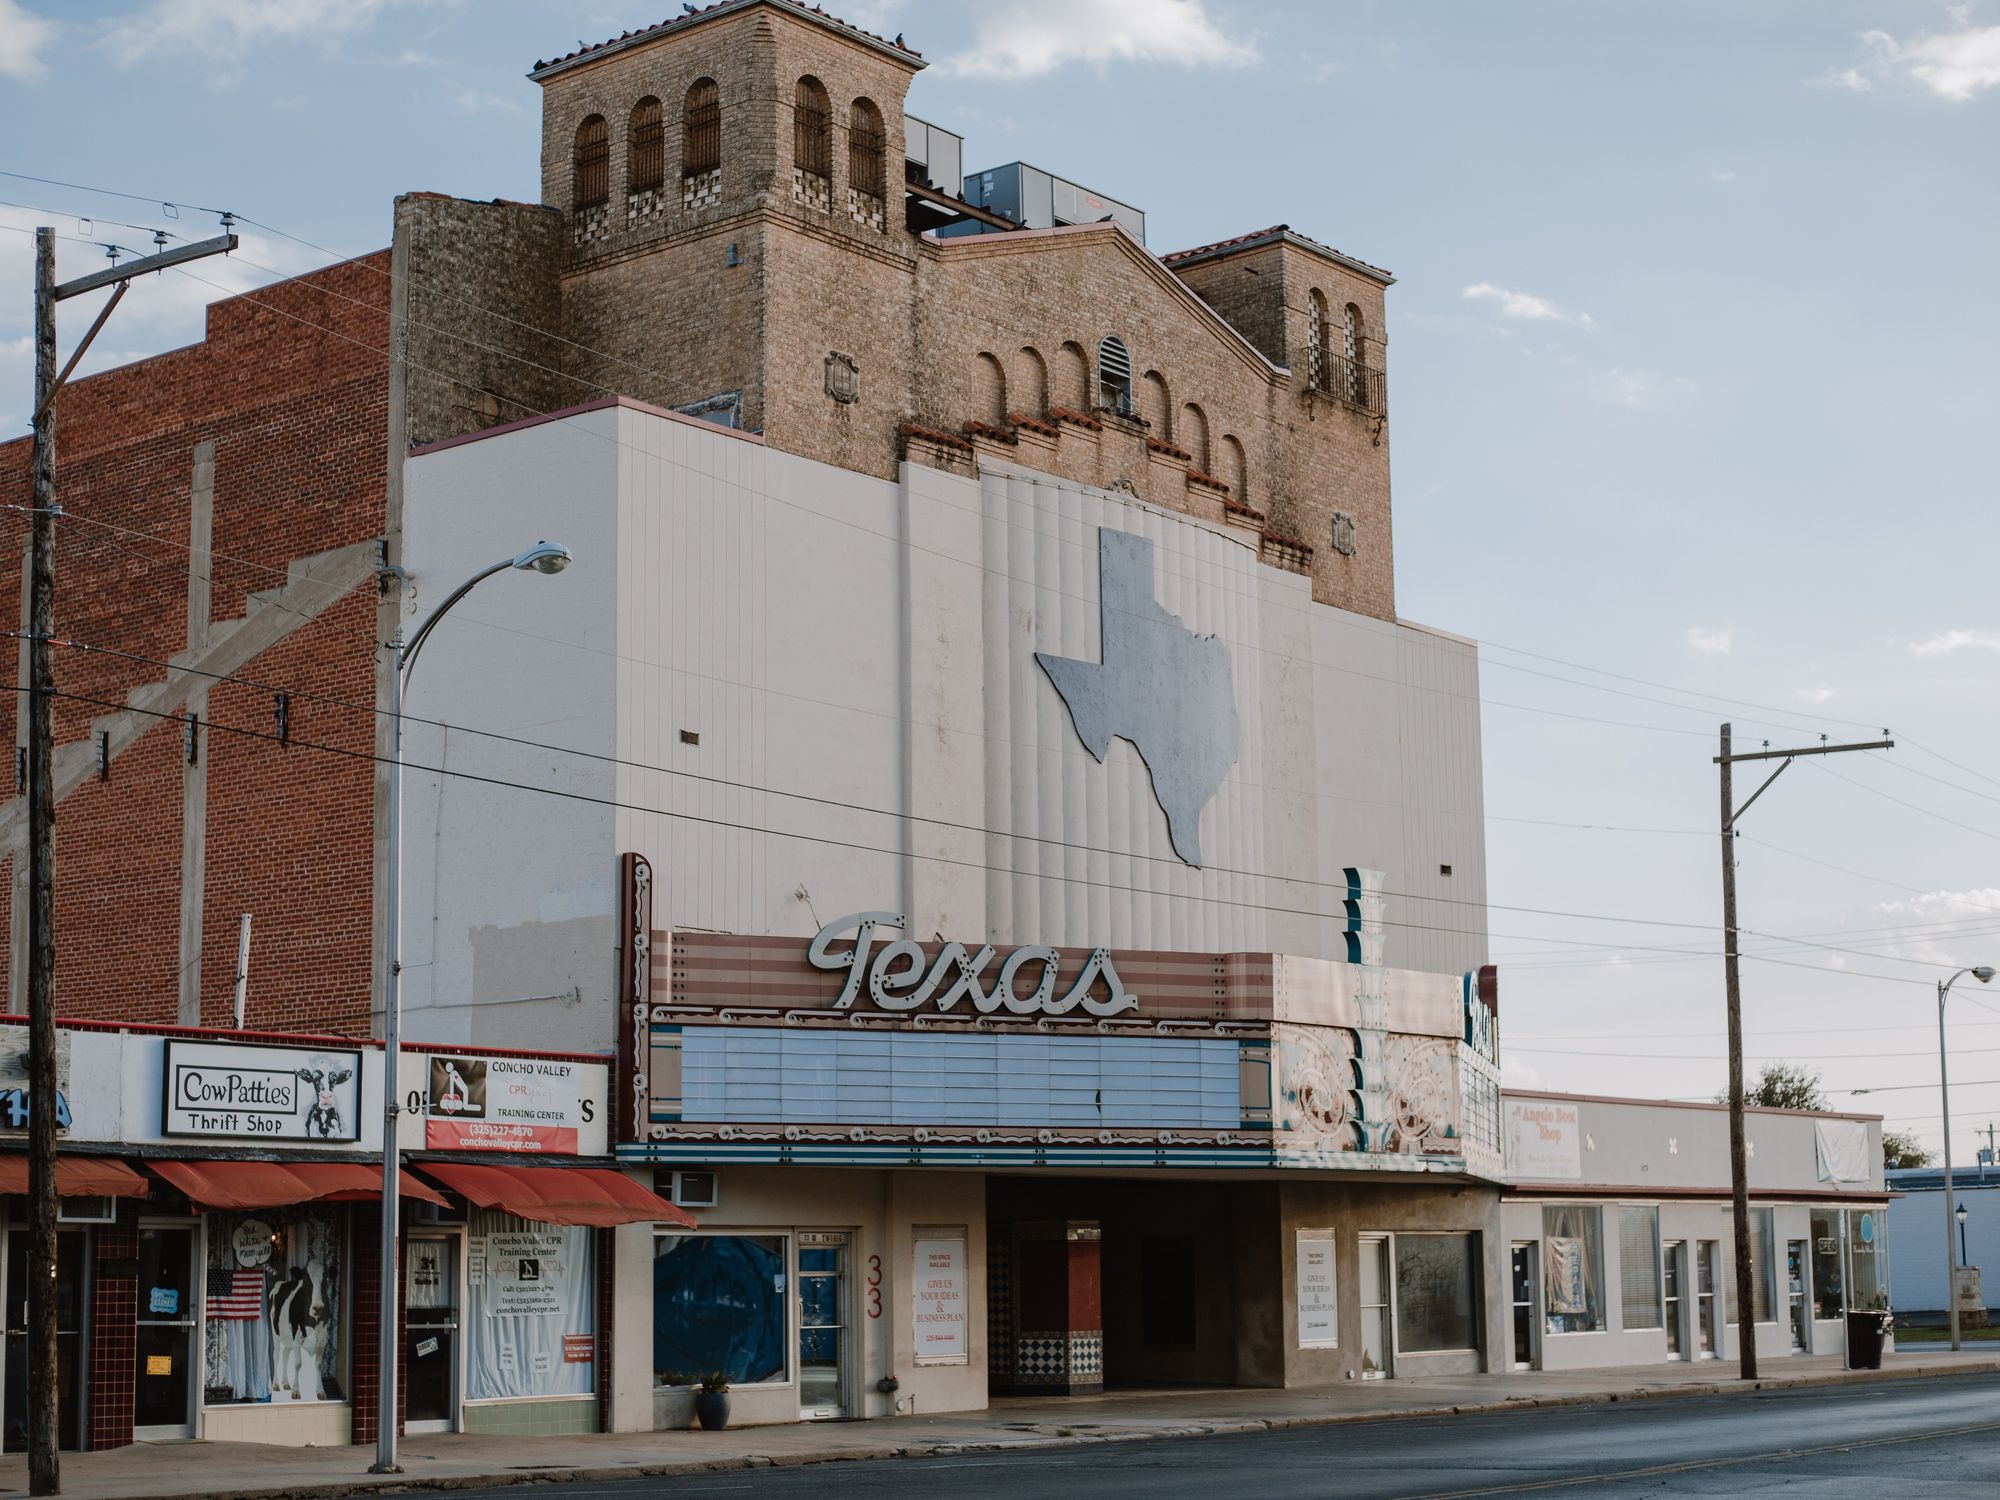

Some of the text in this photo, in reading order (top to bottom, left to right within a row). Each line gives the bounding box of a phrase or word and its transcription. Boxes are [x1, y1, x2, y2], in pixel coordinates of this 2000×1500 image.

[808, 911, 1139, 1015] Texas
[492, 1061, 572, 1077] CONCHO VALLEY
[509, 1084, 528, 1096] CPR
[498, 1108, 565, 1120] TRAINING CENTER
[188, 1113, 282, 1134] Thrift Shop
[469, 1123, 533, 1138] (325)227-4870
[460, 1137, 541, 1151] conchovalleycpr.com
[492, 1236, 562, 1246] Concho Valy CPR
[499, 1247, 557, 1257] Training Center
[867, 1254, 882, 1319] 33
[920, 1292, 960, 1300] YOUR IDEAS
[936, 1301, 944, 1313] &
